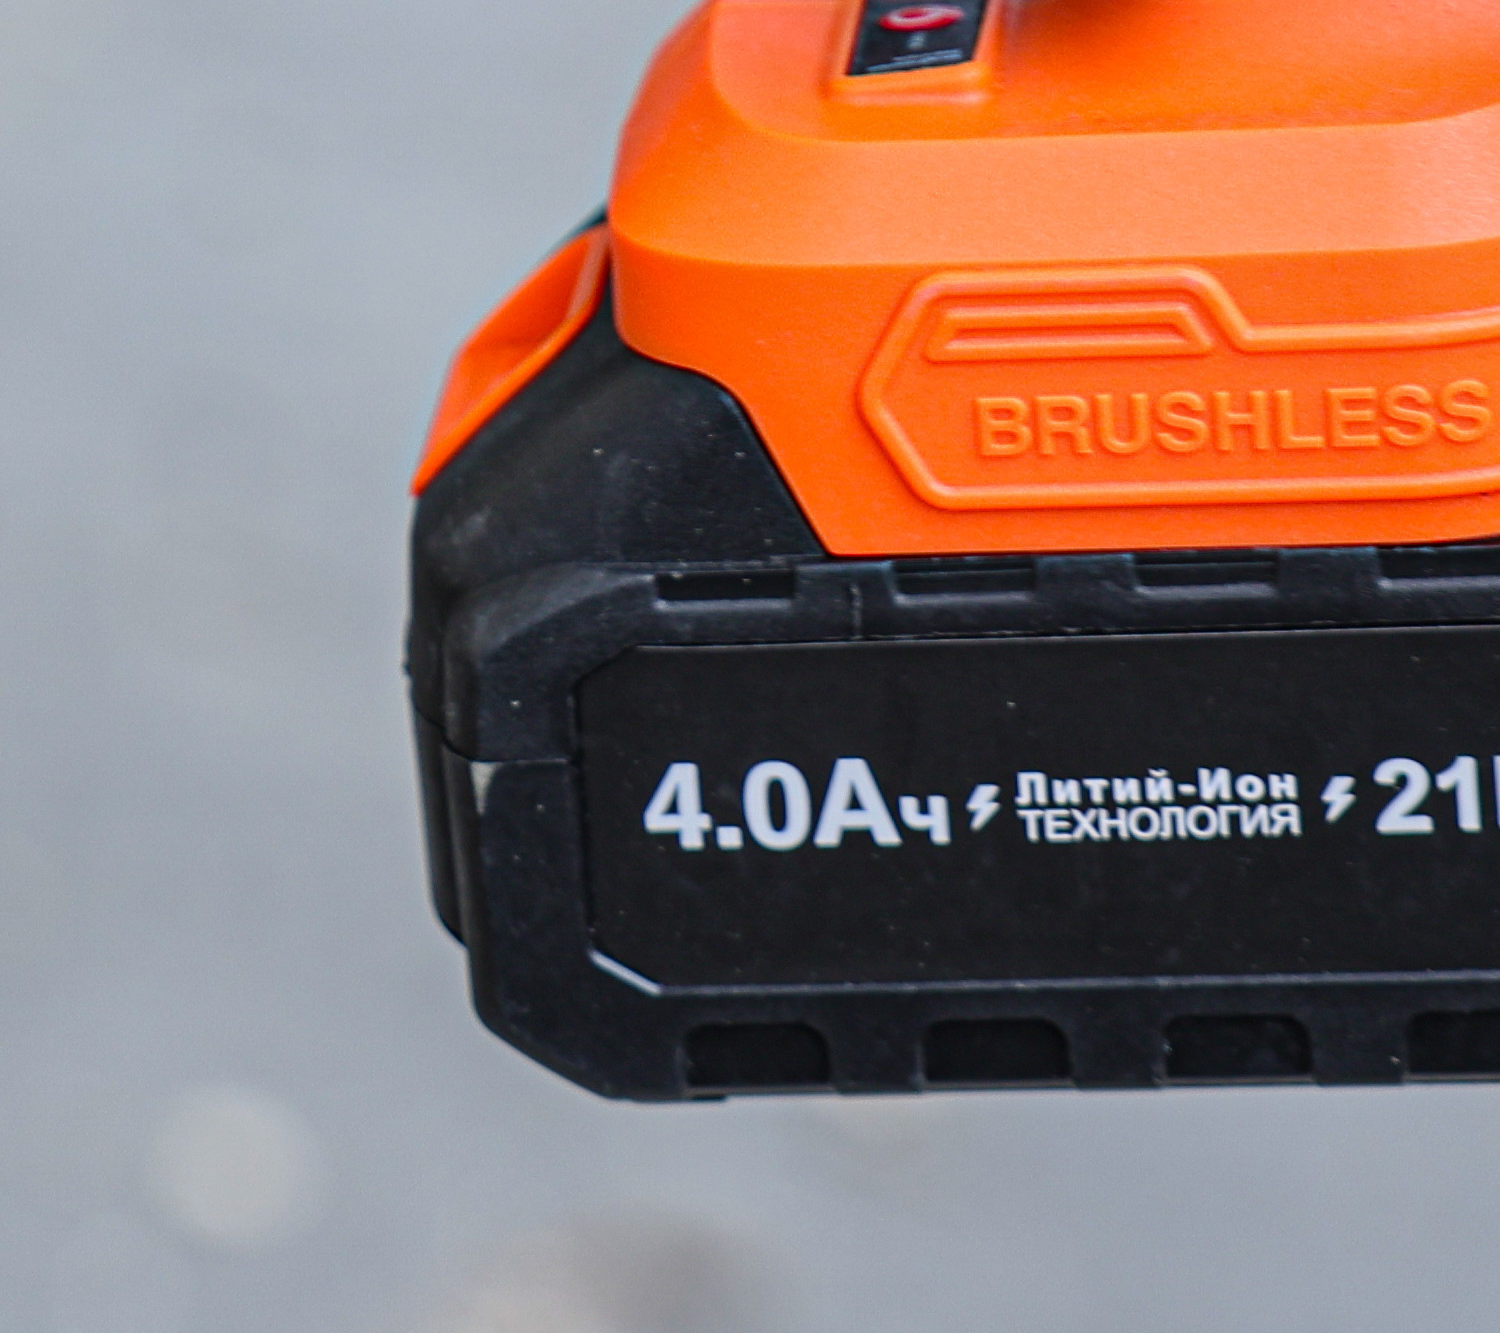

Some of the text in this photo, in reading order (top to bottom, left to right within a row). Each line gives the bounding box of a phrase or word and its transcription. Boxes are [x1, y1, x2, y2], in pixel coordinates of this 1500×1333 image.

[973, 378, 1494, 458] BRUSHLESS
[642, 756, 952, 851] 4.0Ач
[1014, 766, 1300, 807] Литий-Ион
[1015, 802, 1304, 844] ТЕХНОЛОГИЯ
